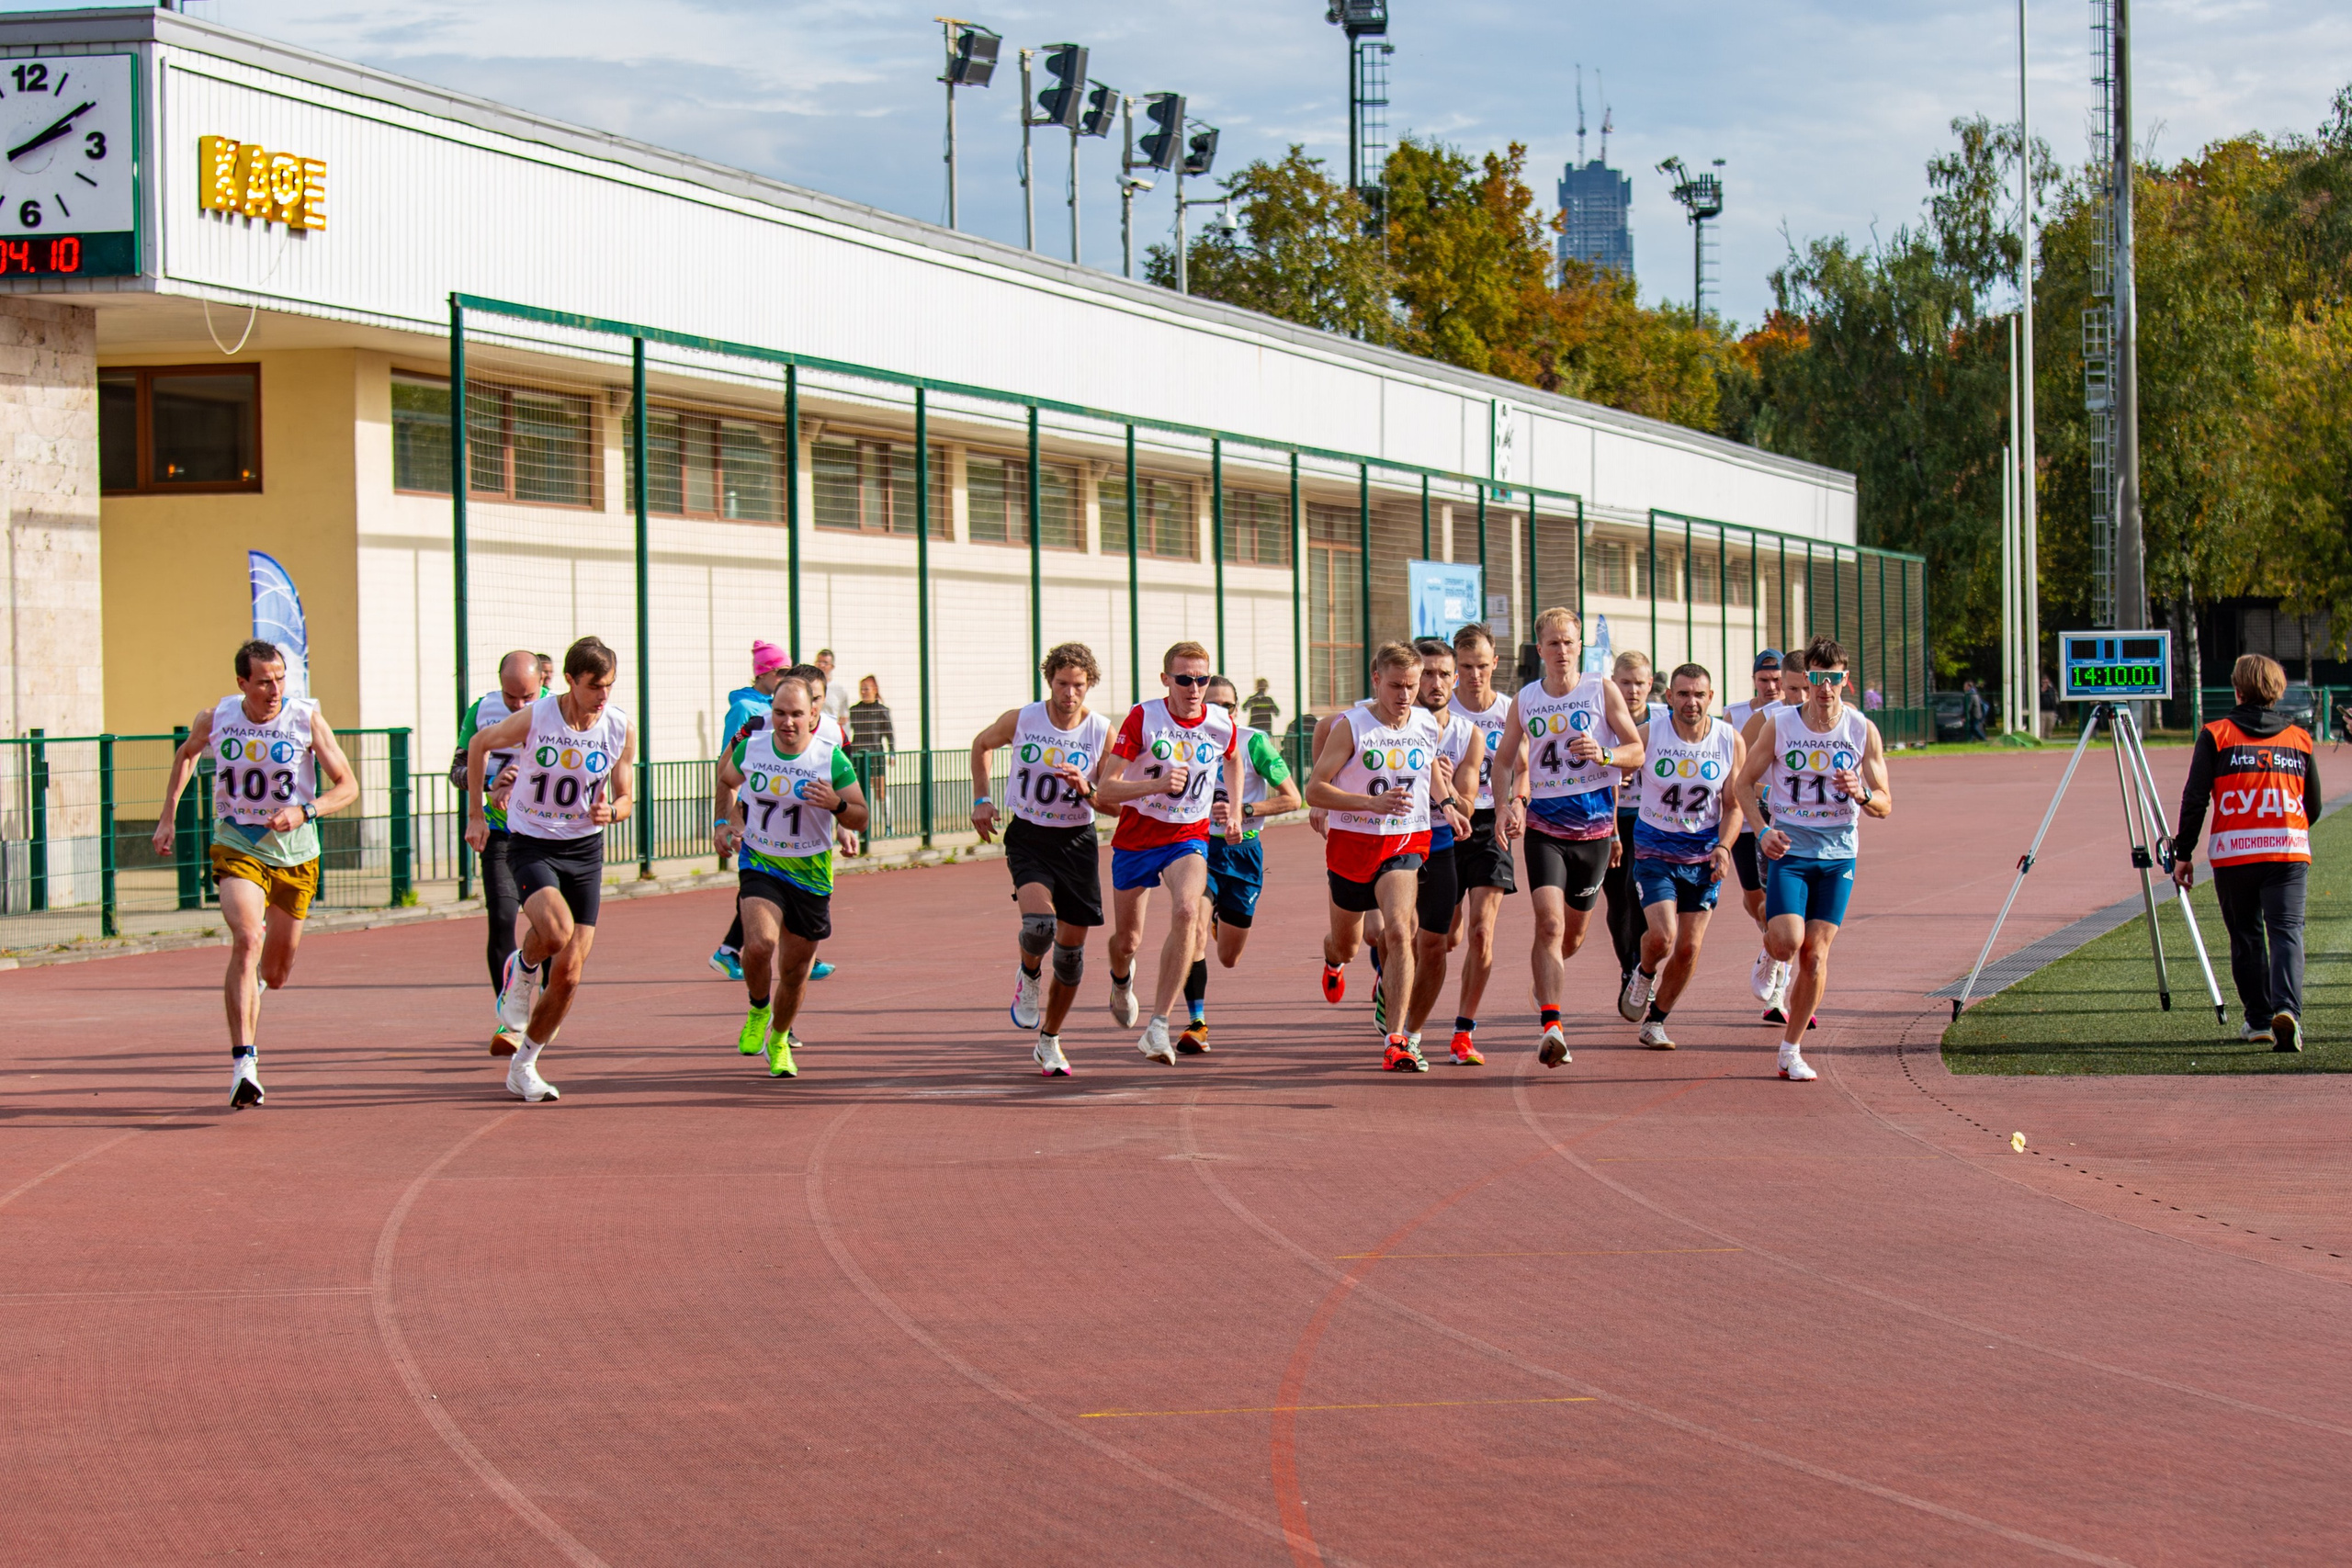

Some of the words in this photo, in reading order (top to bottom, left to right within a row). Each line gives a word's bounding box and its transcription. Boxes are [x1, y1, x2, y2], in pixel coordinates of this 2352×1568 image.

[12, 64, 48, 92] 12
[85, 131, 107, 160] 3
[19, 200, 41, 228] 6
[2074, 666, 2155, 686] 14:10.01
[1526, 700, 1590, 716] VMARAFONE
[222, 727, 296, 739] VMARAFONE
[1155, 730, 1216, 740] VMARAFONE
[538, 735, 608, 750] VMARAFONE
[1024, 734, 1091, 751] VMARAFONE
[1363, 738, 1425, 748] VMARAFONE
[1786, 740, 1854, 750] VMARAFONE
[1657, 749, 1721, 760] VMARAFONE
[2230, 754, 2255, 766] Arta
[2274, 753, 2301, 769] Sport
[752, 762, 818, 778] VMARAFONE
[219, 766, 297, 803] 103
[1660, 784, 1711, 814] 42
[755, 796, 803, 837] 71
